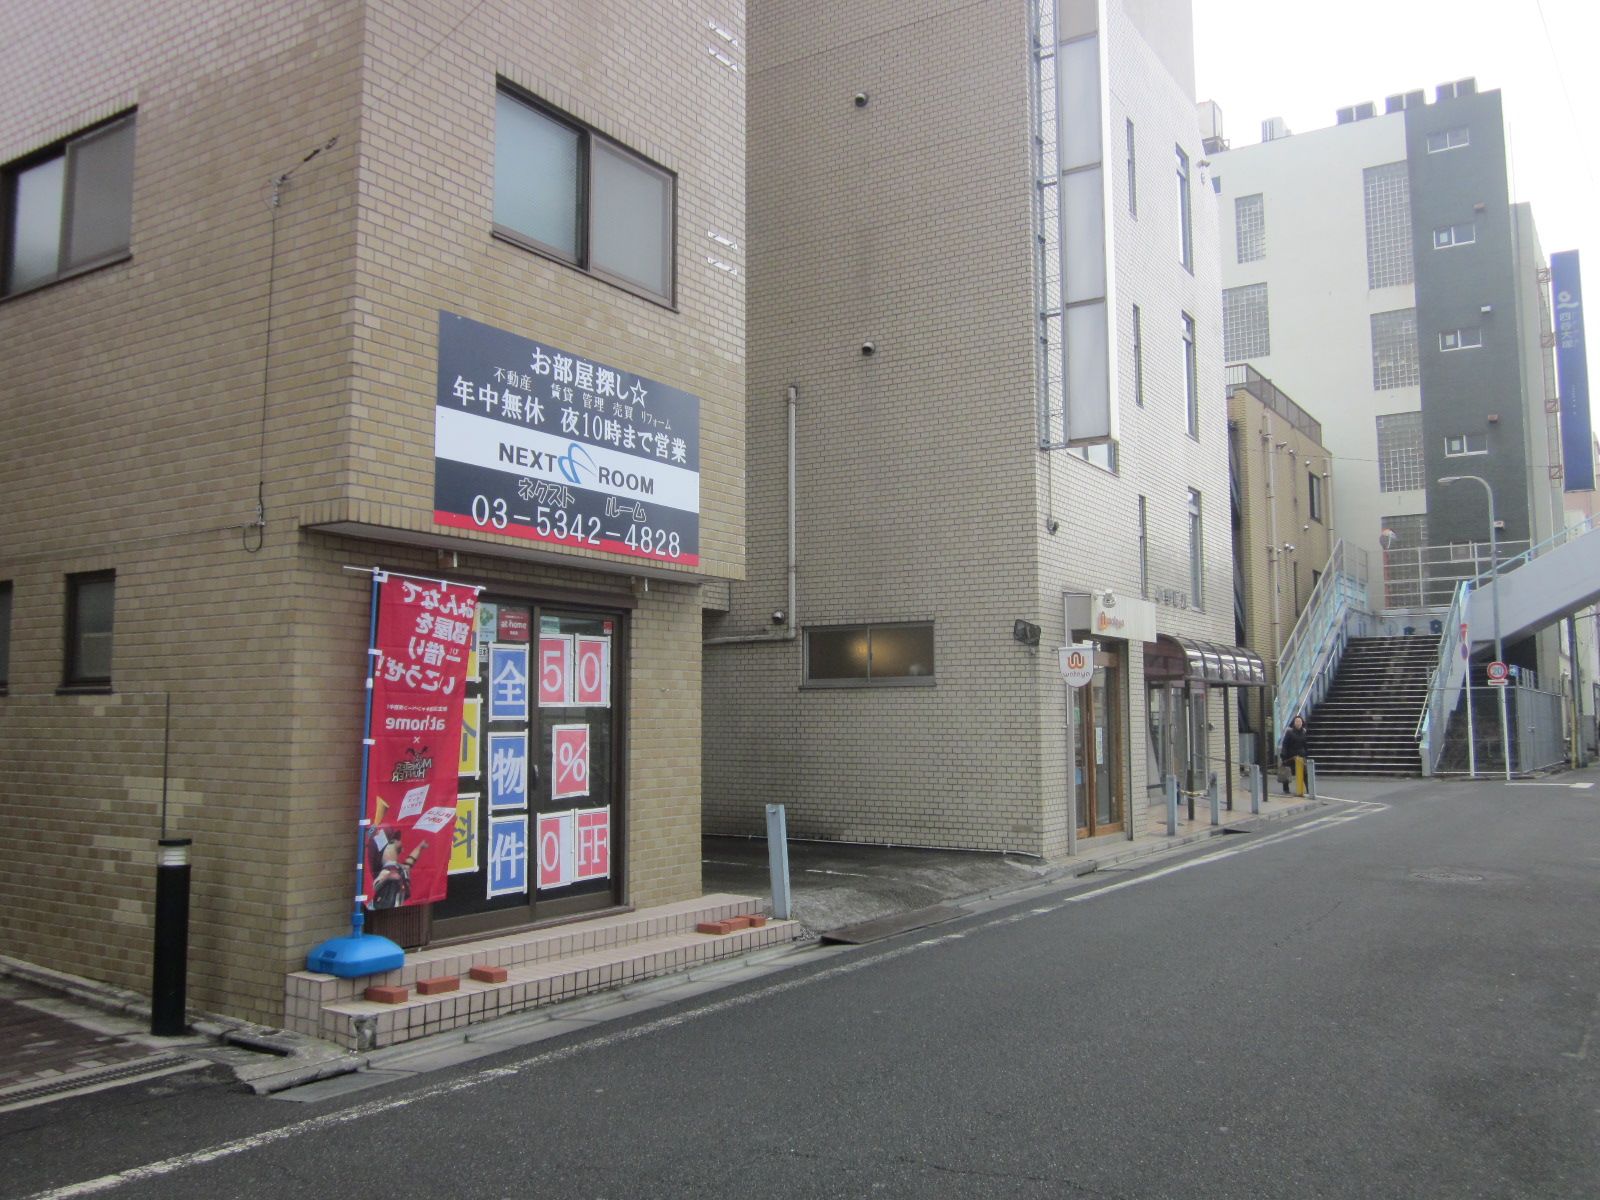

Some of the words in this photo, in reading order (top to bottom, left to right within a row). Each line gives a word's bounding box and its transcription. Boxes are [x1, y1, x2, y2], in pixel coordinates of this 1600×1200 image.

[453, 375, 545, 425] 年中無休
[560, 406, 687, 464] 夜10時まで営業
[493, 366, 532, 392] 不動産
[582, 392, 605, 412] 管理
[612, 402, 634, 422] 売買
[498, 442, 557, 473] NEXT
[598, 466, 655, 495] ROOM
[471, 494, 681, 558] 03-5342-4828
[518, 477, 576, 509] ネクスト
[604, 496, 647, 523] ルーム
[542, 650, 600, 693] 50
